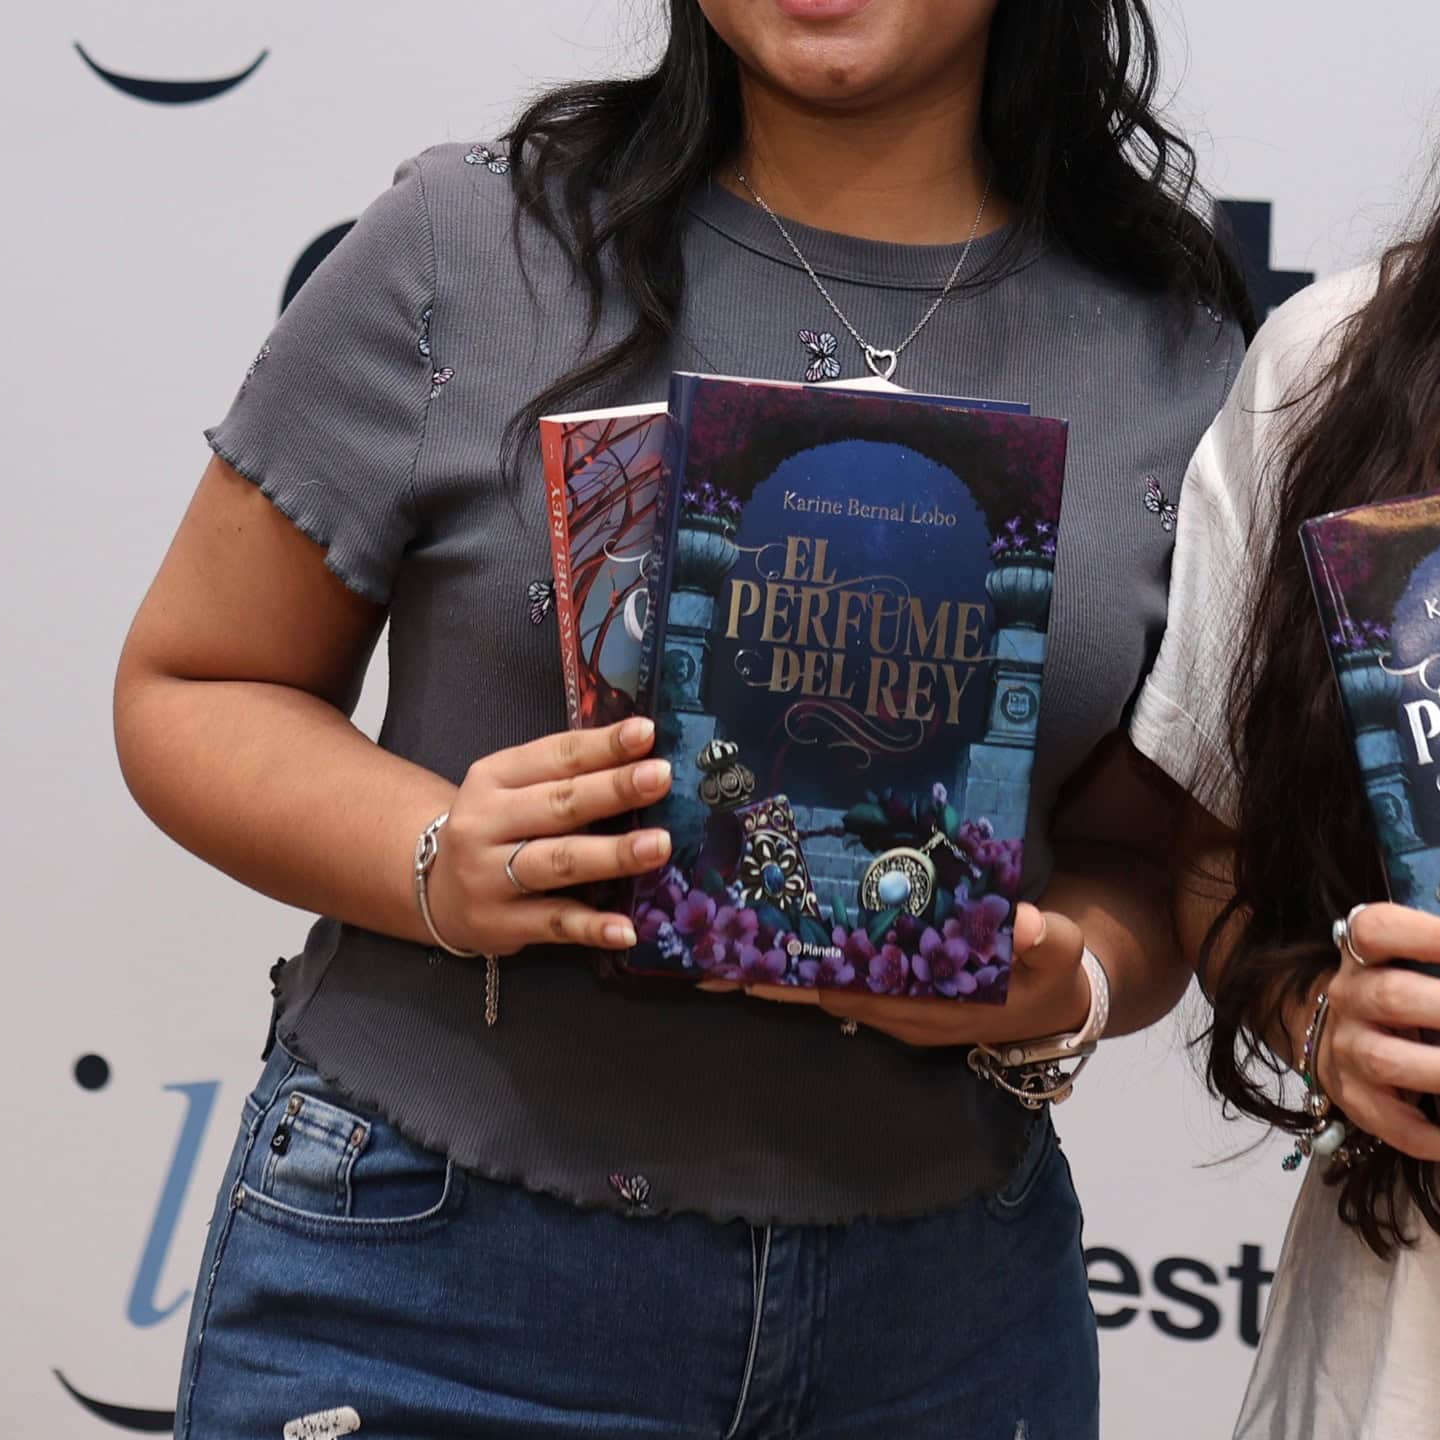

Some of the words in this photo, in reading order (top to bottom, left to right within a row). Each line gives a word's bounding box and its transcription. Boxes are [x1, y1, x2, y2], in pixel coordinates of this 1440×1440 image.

[782, 490, 844, 516] Karine
[847, 498, 906, 523] Bernal
[910, 504, 958, 528] Lobo
[781, 534, 838, 585] EL
[725, 578, 988, 663] PERFUME
[767, 646, 856, 700] DEL
[862, 655, 978, 725] REY
[802, 942, 843, 959] Planeta
